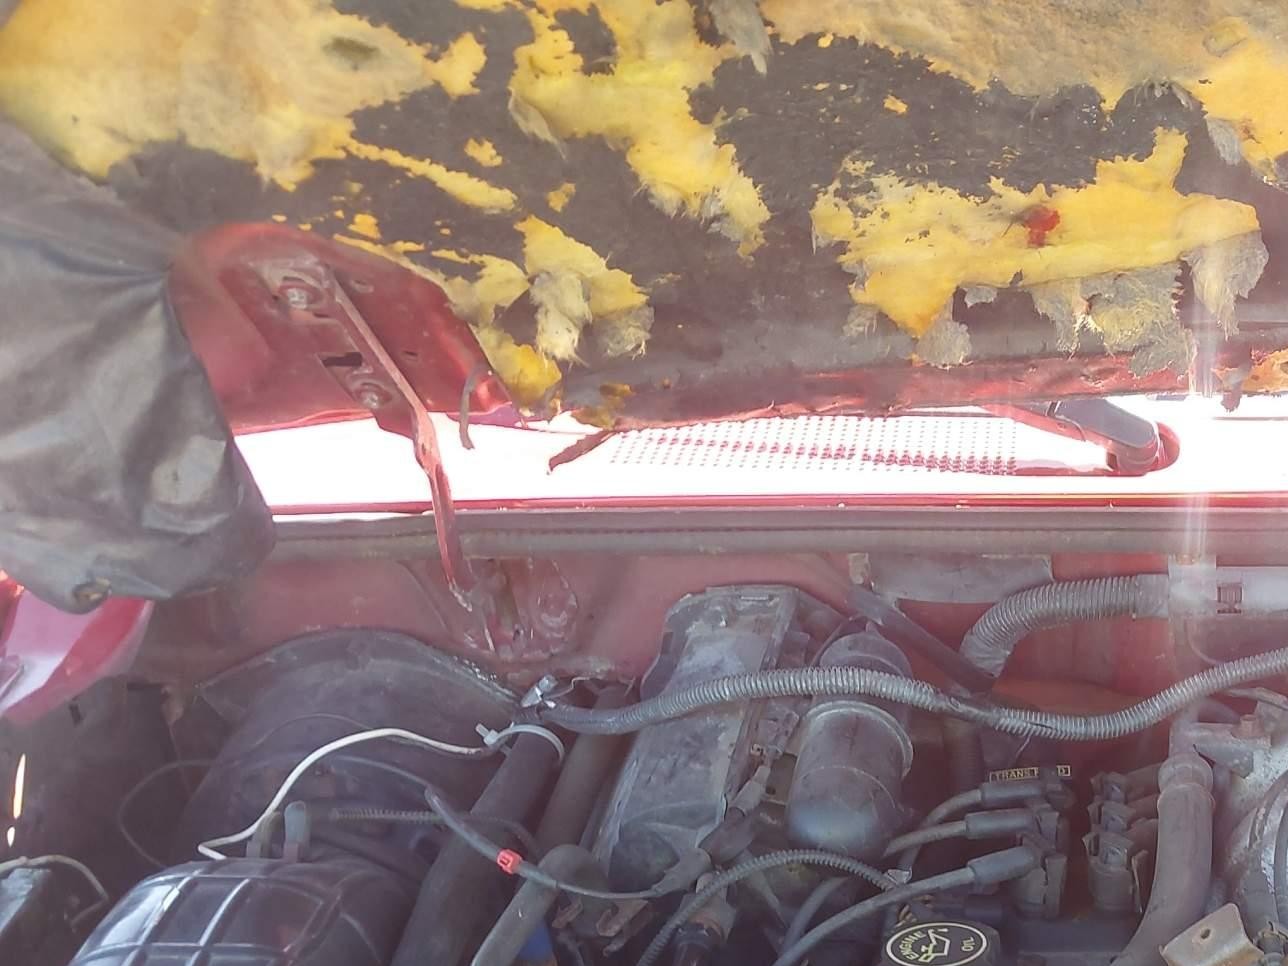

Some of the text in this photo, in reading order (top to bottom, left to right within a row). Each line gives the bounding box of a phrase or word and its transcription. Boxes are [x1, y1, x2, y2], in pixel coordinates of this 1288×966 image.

[994, 769, 1031, 781] TRANS
[899, 930, 975, 960] ENGINE OIL
